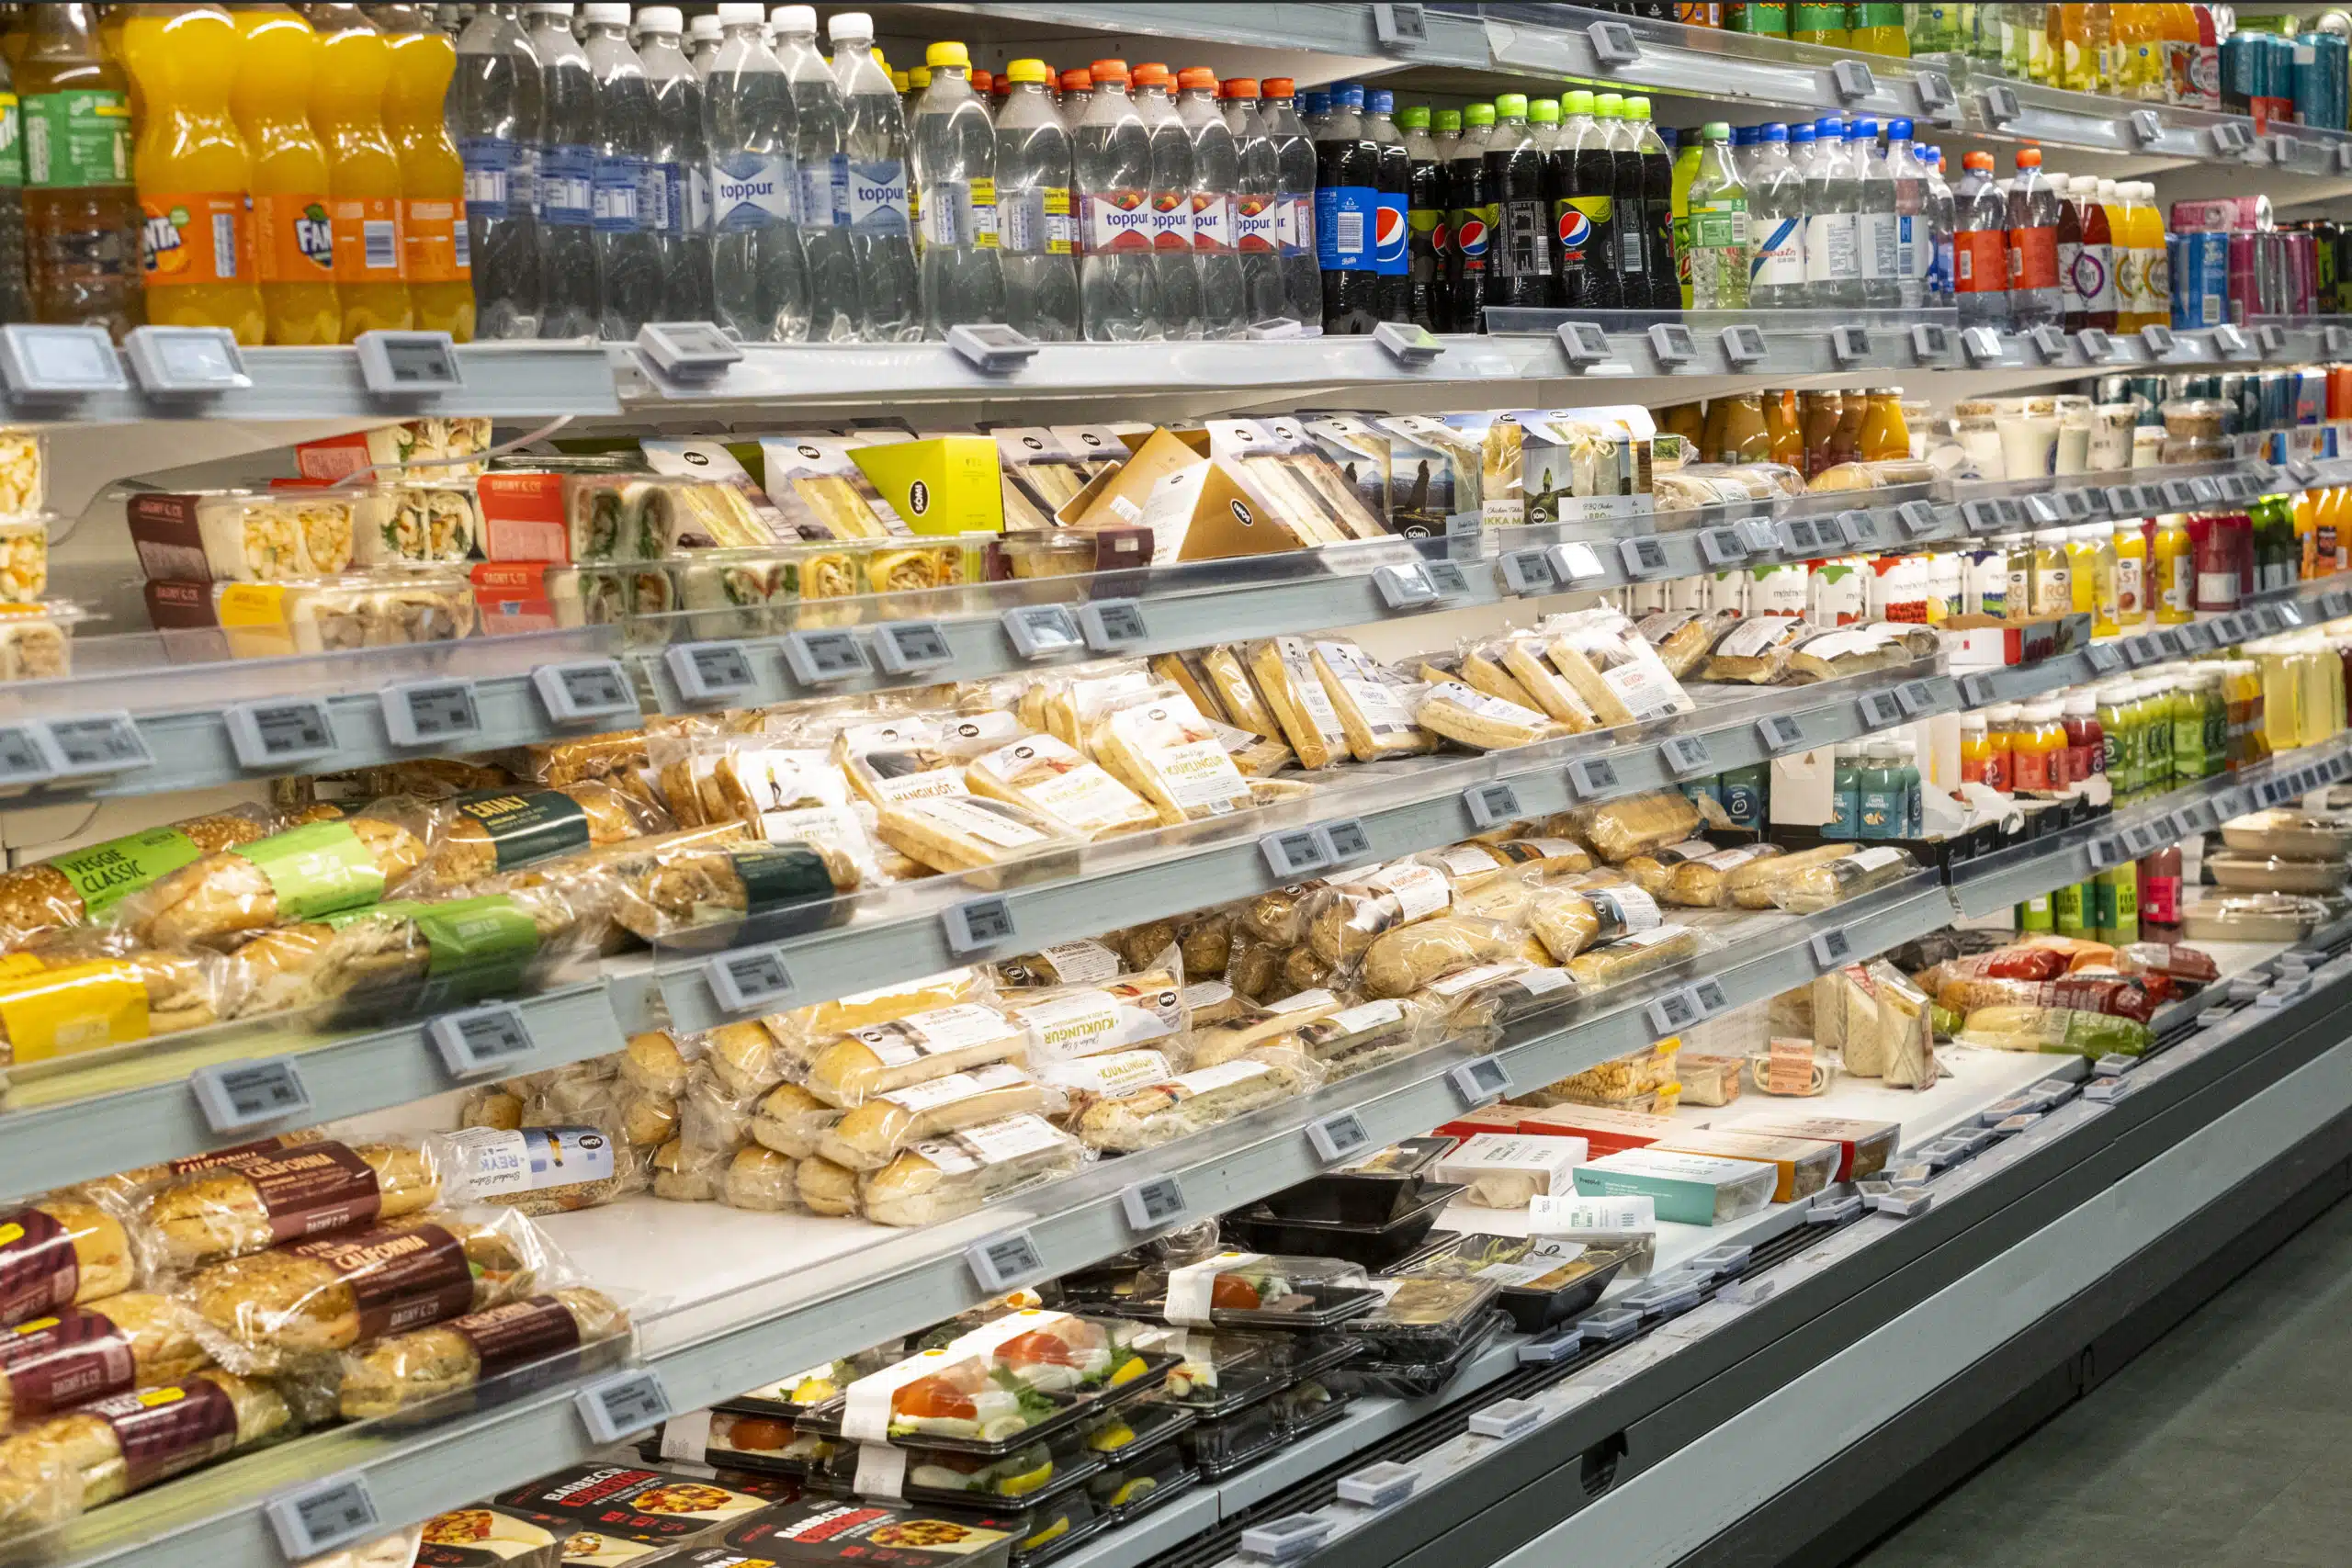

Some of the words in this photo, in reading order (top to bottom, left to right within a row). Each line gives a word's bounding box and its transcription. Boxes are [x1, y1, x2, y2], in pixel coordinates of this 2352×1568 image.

[720, 182, 774, 201] toppur
[1106, 212, 1148, 230] toppur
[1153, 213, 1186, 229] oppur
[1194, 215, 1218, 230] pur
[1239, 218, 1271, 231] oppur
[143, 217, 182, 253] NTA
[295, 218, 333, 253] FAN
[914, 485, 923, 512] SÓMI
[1484, 517, 1510, 525] IKKA
[65, 848, 127, 874] VEGGIE
[81, 859, 147, 893] CLASSIC
[243, 1152, 336, 1179] CALIFORNIA
[492, 1170, 520, 1183] Smoked
[334, 1235, 430, 1269] CALIFORNIA
